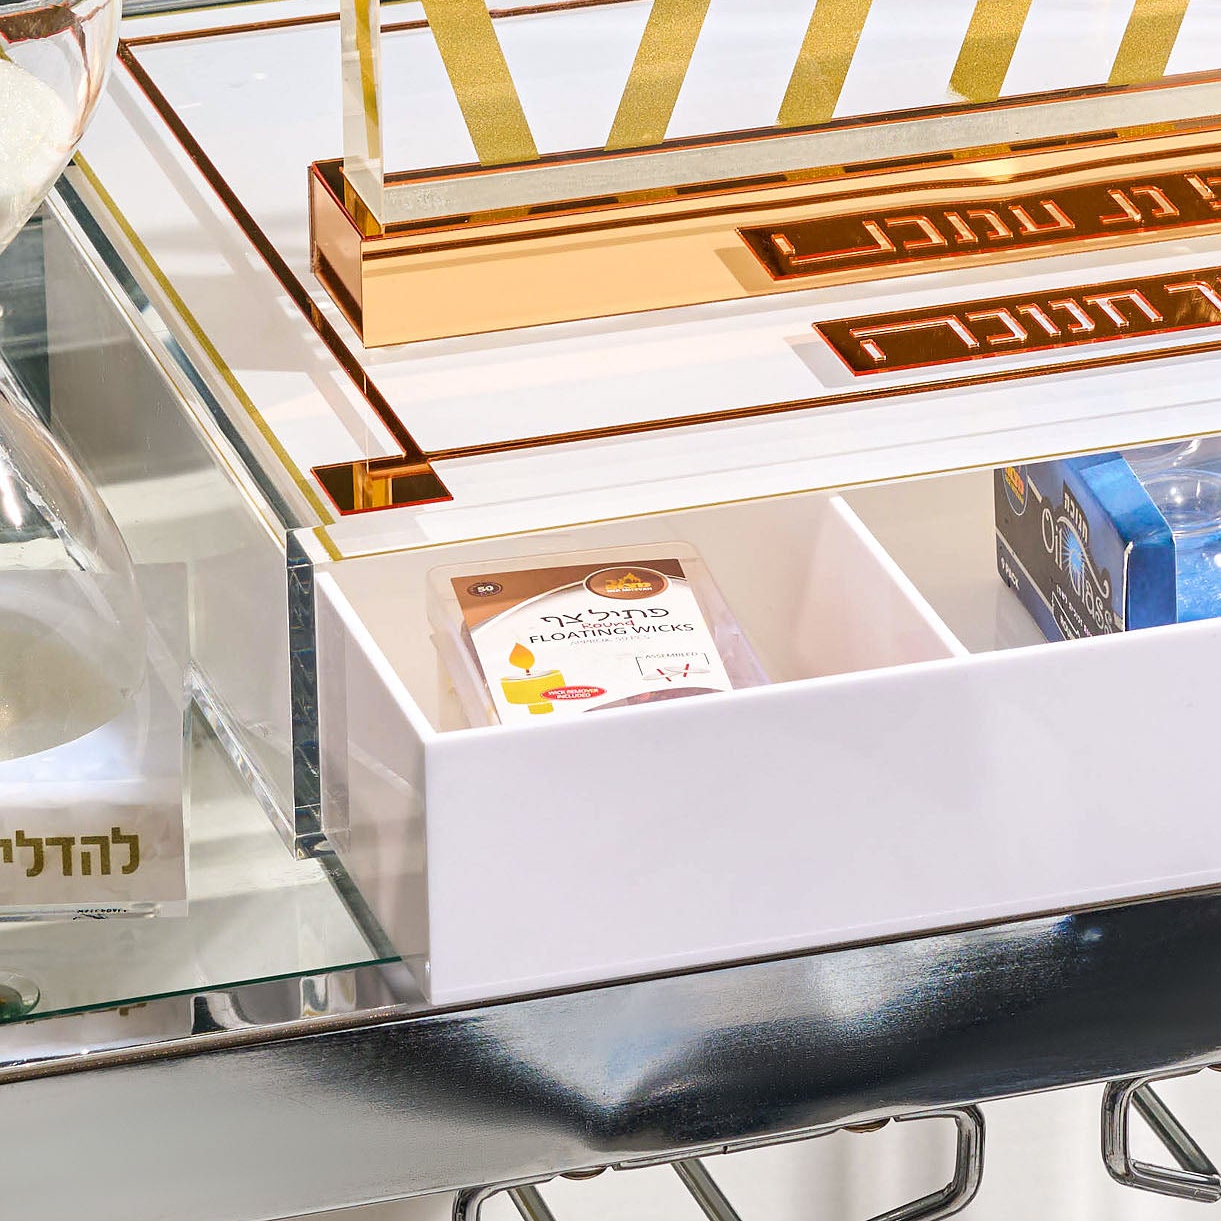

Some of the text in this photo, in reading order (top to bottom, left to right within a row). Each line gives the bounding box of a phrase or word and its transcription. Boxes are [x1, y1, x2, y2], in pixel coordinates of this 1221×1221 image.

[849, 288, 1164, 362] חנוכה
[1041, 507, 1064, 571] Oil
[477, 585, 494, 593] 50
[540, 607, 670, 628] פתיל צף
[581, 619, 635, 630] Round
[529, 626, 627, 644] FLOATING
[632, 623, 694, 634] WICKS
[0, 826, 141, 877] להדלי
